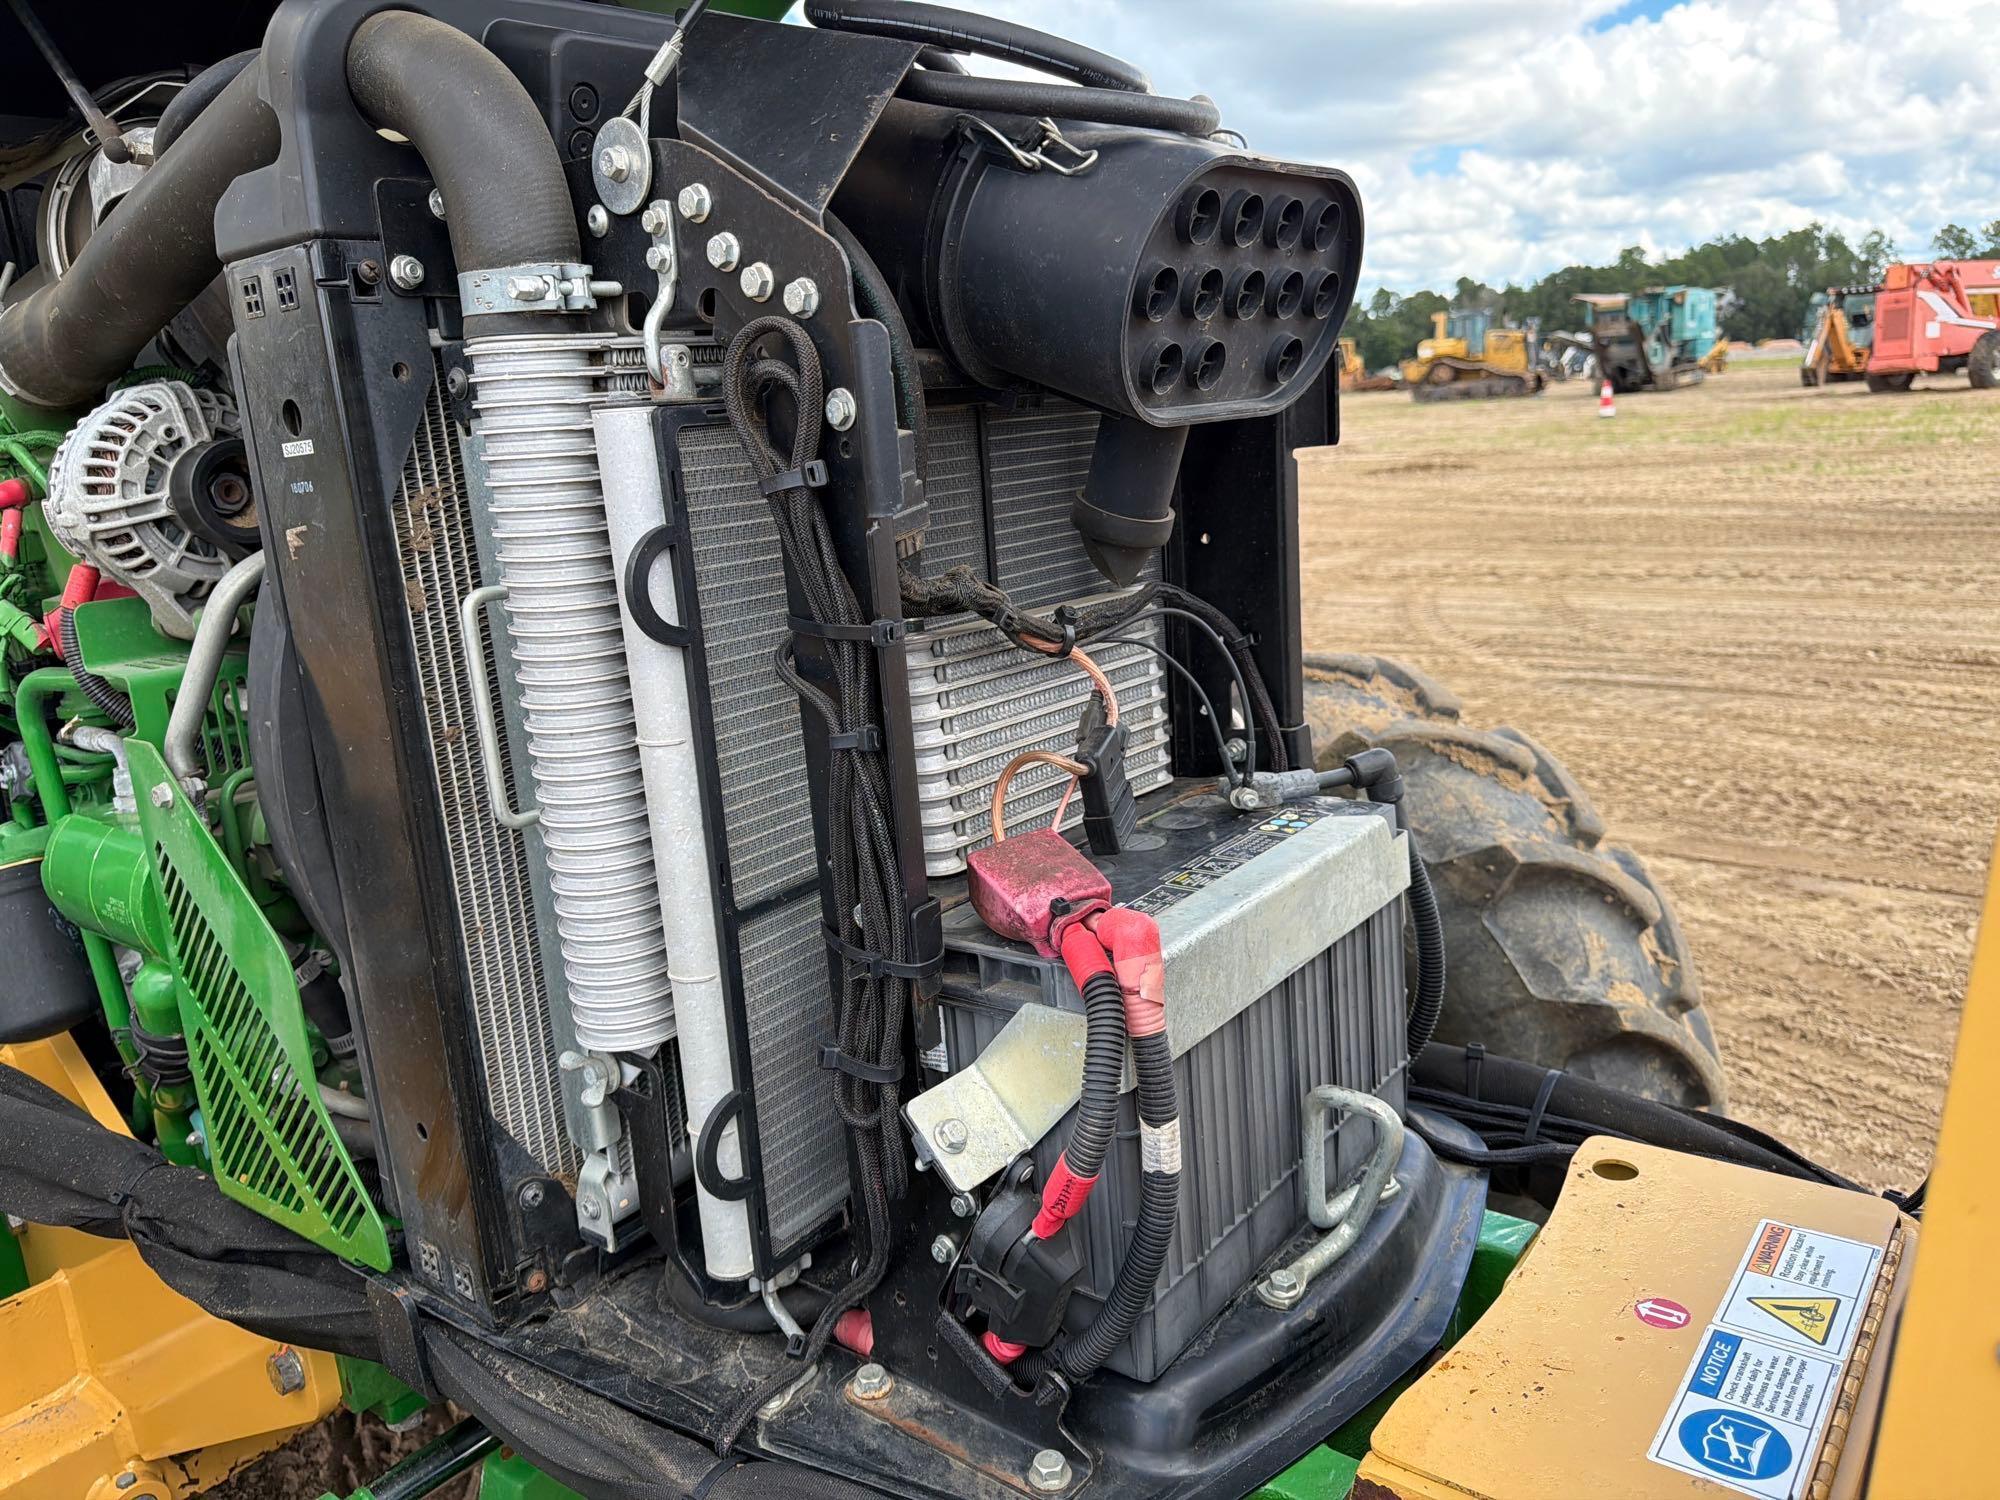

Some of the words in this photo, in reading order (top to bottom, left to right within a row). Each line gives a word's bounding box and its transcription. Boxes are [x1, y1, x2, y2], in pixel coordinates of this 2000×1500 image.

[285, 442, 312, 455] SJ20575
[1755, 1227, 1785, 1264] WARNING
[1779, 1253, 1798, 1278] Rotation
[1790, 1233, 1806, 1253] Hazard
[1793, 1270, 1806, 1281] Stay
[1800, 1258, 1809, 1270] clear
[1805, 1246, 1815, 1258] while
[1808, 1259, 1823, 1285] equipment
[1700, 1341, 1731, 1386] NOTICE
[1749, 1368, 1762, 1382] daily
[1753, 1359, 1763, 1367] for
[1765, 1369, 1774, 1381] and
[1769, 1355, 1780, 1369] wear.
[1791, 1359, 1808, 1385] improper
[1724, 1381, 1739, 1400] Check
[1736, 1352, 1752, 1382] crankshaft
[1765, 1390, 1780, 1413] Serious
[1775, 1367, 1791, 1390] damage
[1785, 1355, 1796, 1367] may
[1740, 1382, 1754, 1404] adapter
[1752, 1381, 1769, 1409] tightness
[1786, 1386, 1798, 1400] from
[1794, 1384, 1815, 1422] maintenance.
[1781, 1400, 1793, 1418] result
